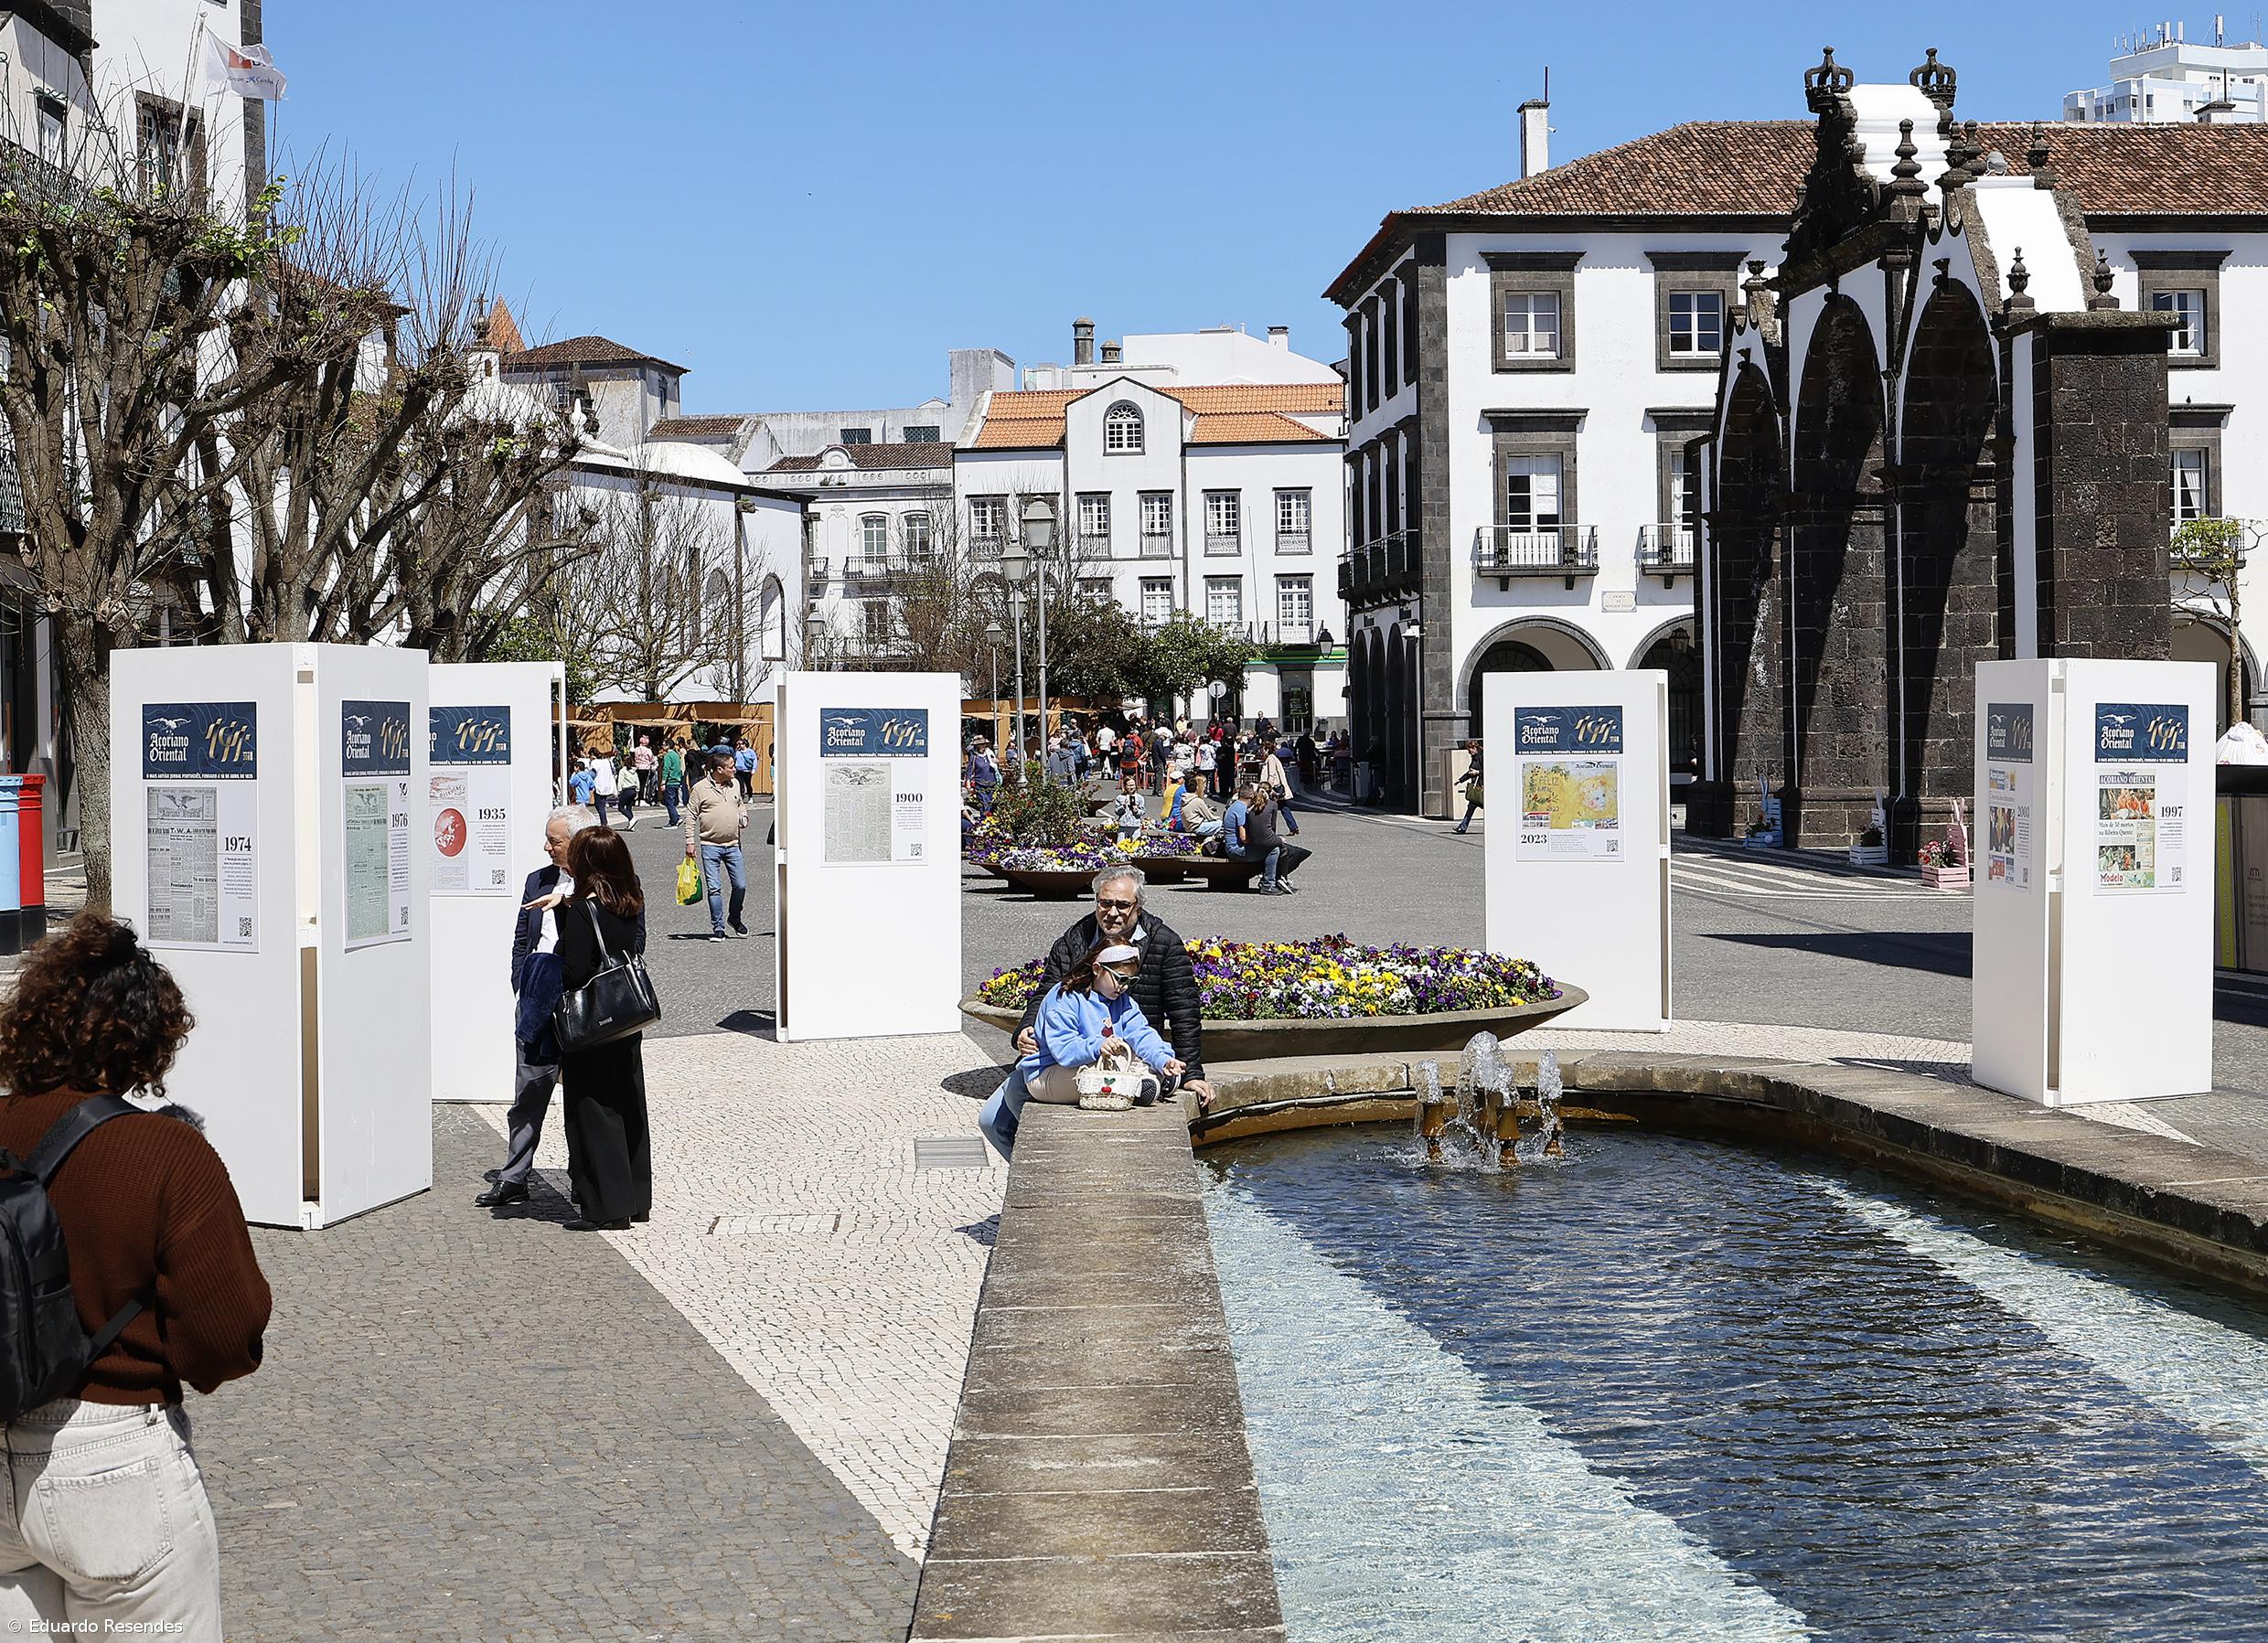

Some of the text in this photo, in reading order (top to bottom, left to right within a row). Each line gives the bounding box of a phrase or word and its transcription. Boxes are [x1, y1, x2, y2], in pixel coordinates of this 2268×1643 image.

[827, 726, 866, 738] Açoriano
[1522, 725, 1559, 736] Açoriano
[2101, 726, 2134, 739] Açoriano
[149, 732, 189, 748] Açoriano
[347, 730, 371, 746] Açoriano
[827, 736, 864, 746] Oriental
[1522, 734, 1557, 744] Oriental
[2101, 738, 2132, 749] Oriental
[149, 747, 187, 762] Oriental
[347, 744, 369, 759] Oriental
[2100, 775, 2155, 784] AÇORIANO ORIENTAL
[895, 793, 923, 803] 1900
[478, 808, 506, 820] 1935
[2161, 806, 2183, 817] 1997
[391, 813, 408, 827] 1976
[224, 837, 251, 851] 1974
[1520, 834, 1547, 844] 2023
[2100, 873, 2124, 882] Modelo
